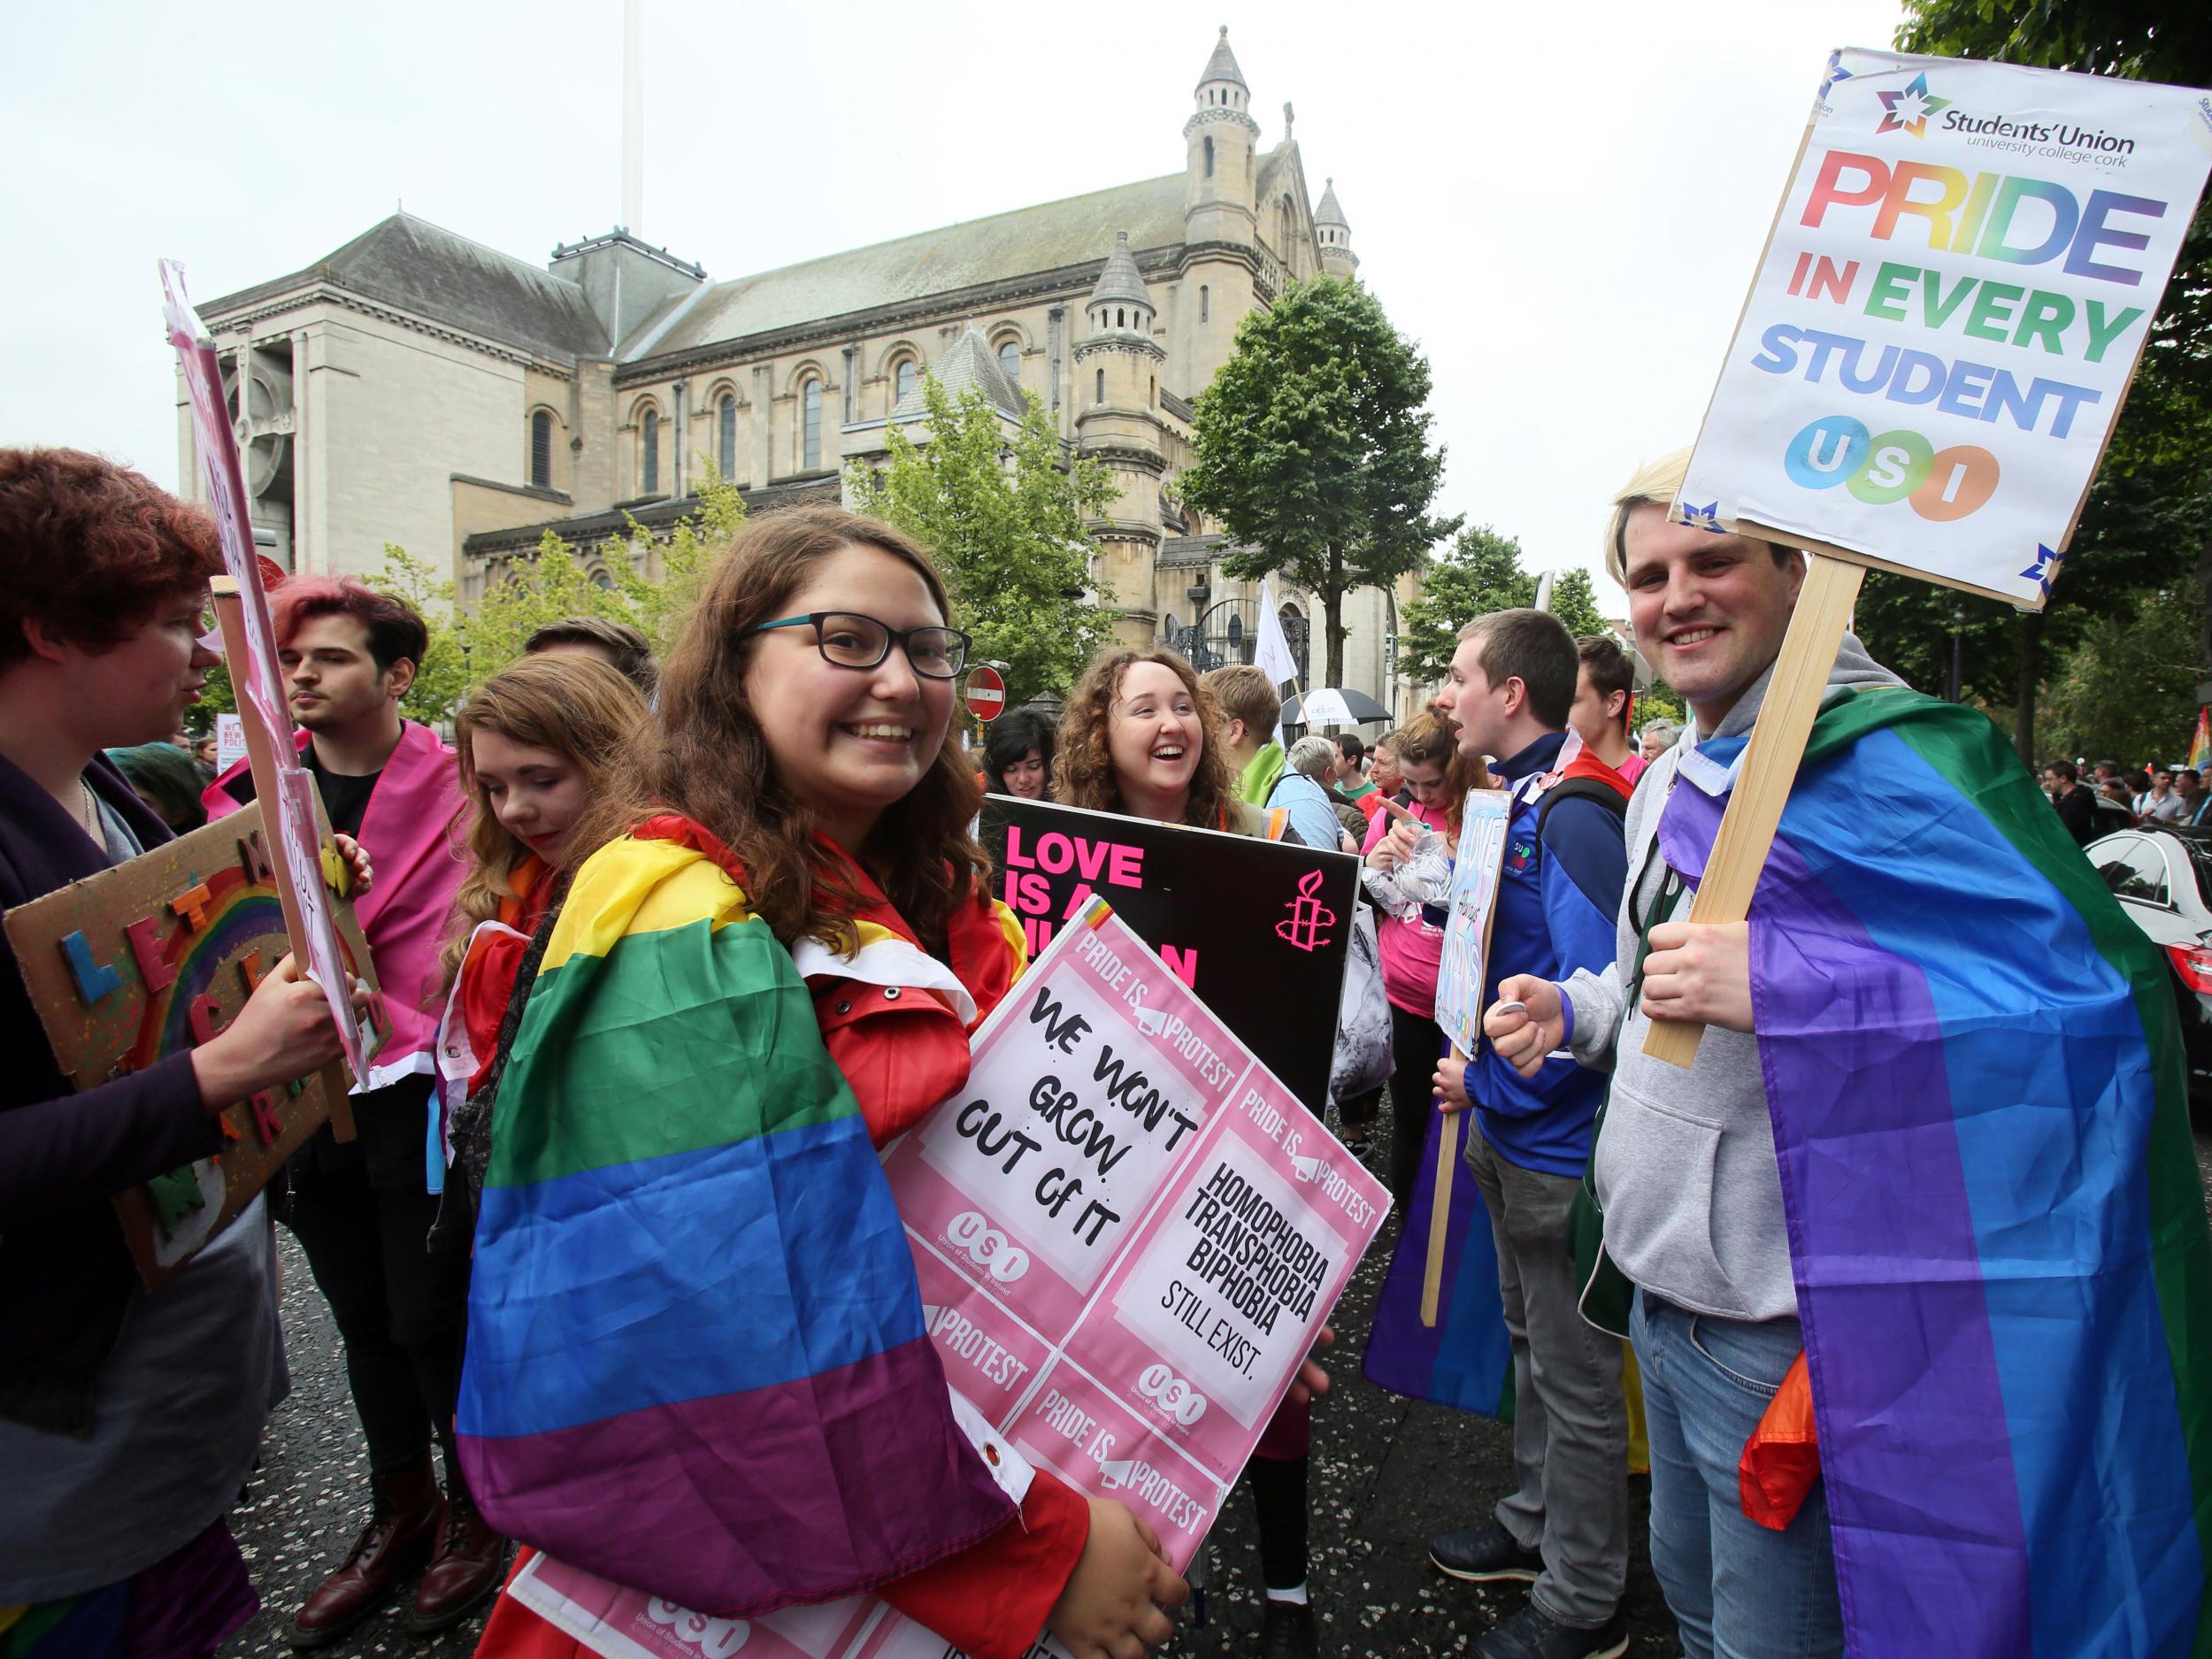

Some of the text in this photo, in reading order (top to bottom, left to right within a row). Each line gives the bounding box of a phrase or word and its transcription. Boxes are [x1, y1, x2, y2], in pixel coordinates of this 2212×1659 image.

[1941, 110, 2135, 155] Students' Union
[1967, 135, 2129, 168] university college cork
[1800, 149, 2169, 287] PRIDE
[1786, 251, 2147, 365] IN EVERY
[1749, 322, 2103, 441] STUDENT
[1805, 427, 1968, 504] USI
[1004, 870, 1051, 915] IS
[1005, 825, 1144, 888] LOVE
[1514, 841, 1524, 853] SU
[1075, 931, 1133, 992] PRIDE
[1122, 978, 1148, 1008] IS
[1164, 1017, 1235, 1093] PROTEST
[1029, 987, 1198, 1152] WE WON'T
[956, 1099, 1042, 1174] OUT
[1072, 1199, 1121, 1247] IT
[1029, 1075, 1133, 1178] GROW
[1239, 1087, 1377, 1230] PRIDE IS PROTEST
[938, 1233, 956, 1251] Union
[954, 1248, 964, 1257] of
[961, 1253, 985, 1276] Students
[990, 1278, 1012, 1296] Ireland
[957, 1216, 1019, 1275] USI
[1185, 1187, 1317, 1324] TRANSPHOBIA
[1205, 1162, 1329, 1291] HOMOPHOBIA
[1161, 1279, 1262, 1381] STILL EXIST.
[1186, 1237, 1281, 1337] BIPHOBIA
[933, 1308, 1029, 1392] PROTEST
[1147, 1367, 1199, 1417] USI
[1131, 1386, 1145, 1401] Union
[1150, 1402, 1171, 1422] Students
[1035, 1388, 1097, 1448] PRIDE
[1087, 1428, 1116, 1463] IS
[1129, 1461, 1208, 1535] PROTEST
[636, 1611, 657, 1631] Union
[656, 1627, 665, 1637] of
[664, 1632, 695, 1656] Students
